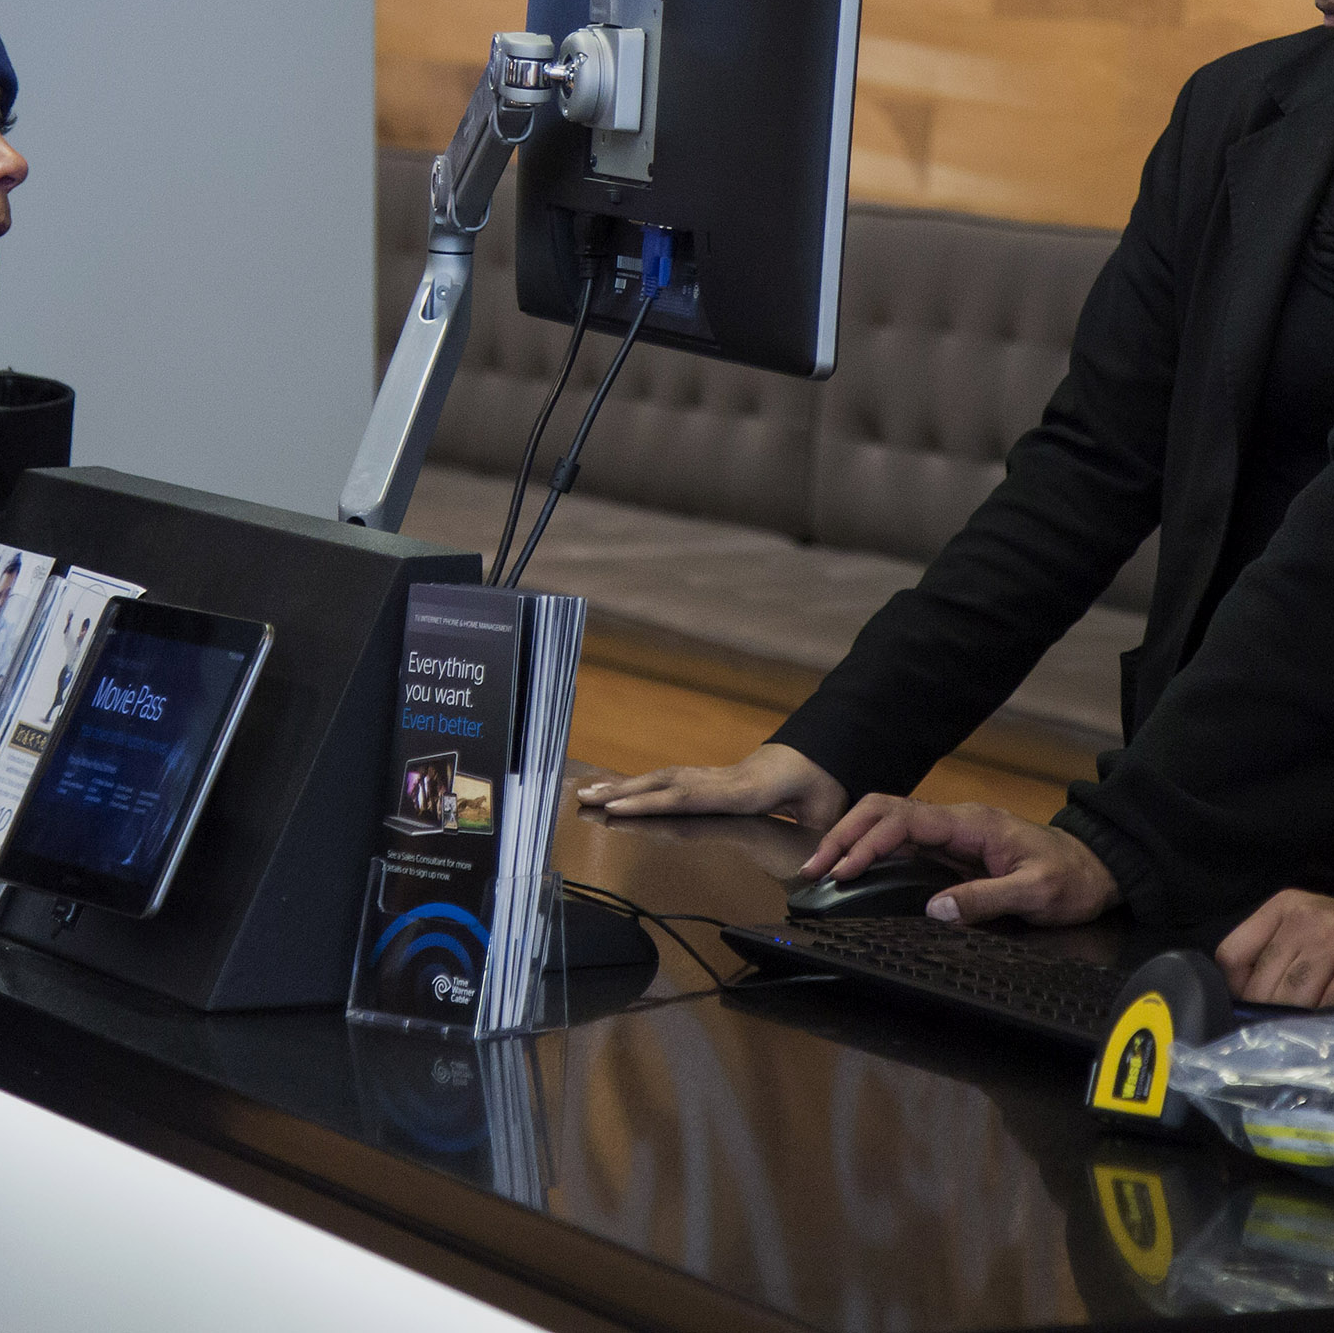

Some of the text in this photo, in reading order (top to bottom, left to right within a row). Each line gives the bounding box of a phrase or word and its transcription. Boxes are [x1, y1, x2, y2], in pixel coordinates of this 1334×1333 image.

[408, 651, 485, 685] Everything
[91, 676, 167, 721] Movie Pass
[405, 683, 474, 708] you want.
[402, 707, 484, 738] Even better.
[415, 854, 447, 867] Consultant
[446, 858, 455, 868] for
[455, 861, 472, 870] more
[415, 868, 427, 878] sign
[427, 871, 436, 880] up
[453, 976, 469, 987] Time
[450, 994, 470, 1004] Cable
[452, 985, 475, 997] Warner
